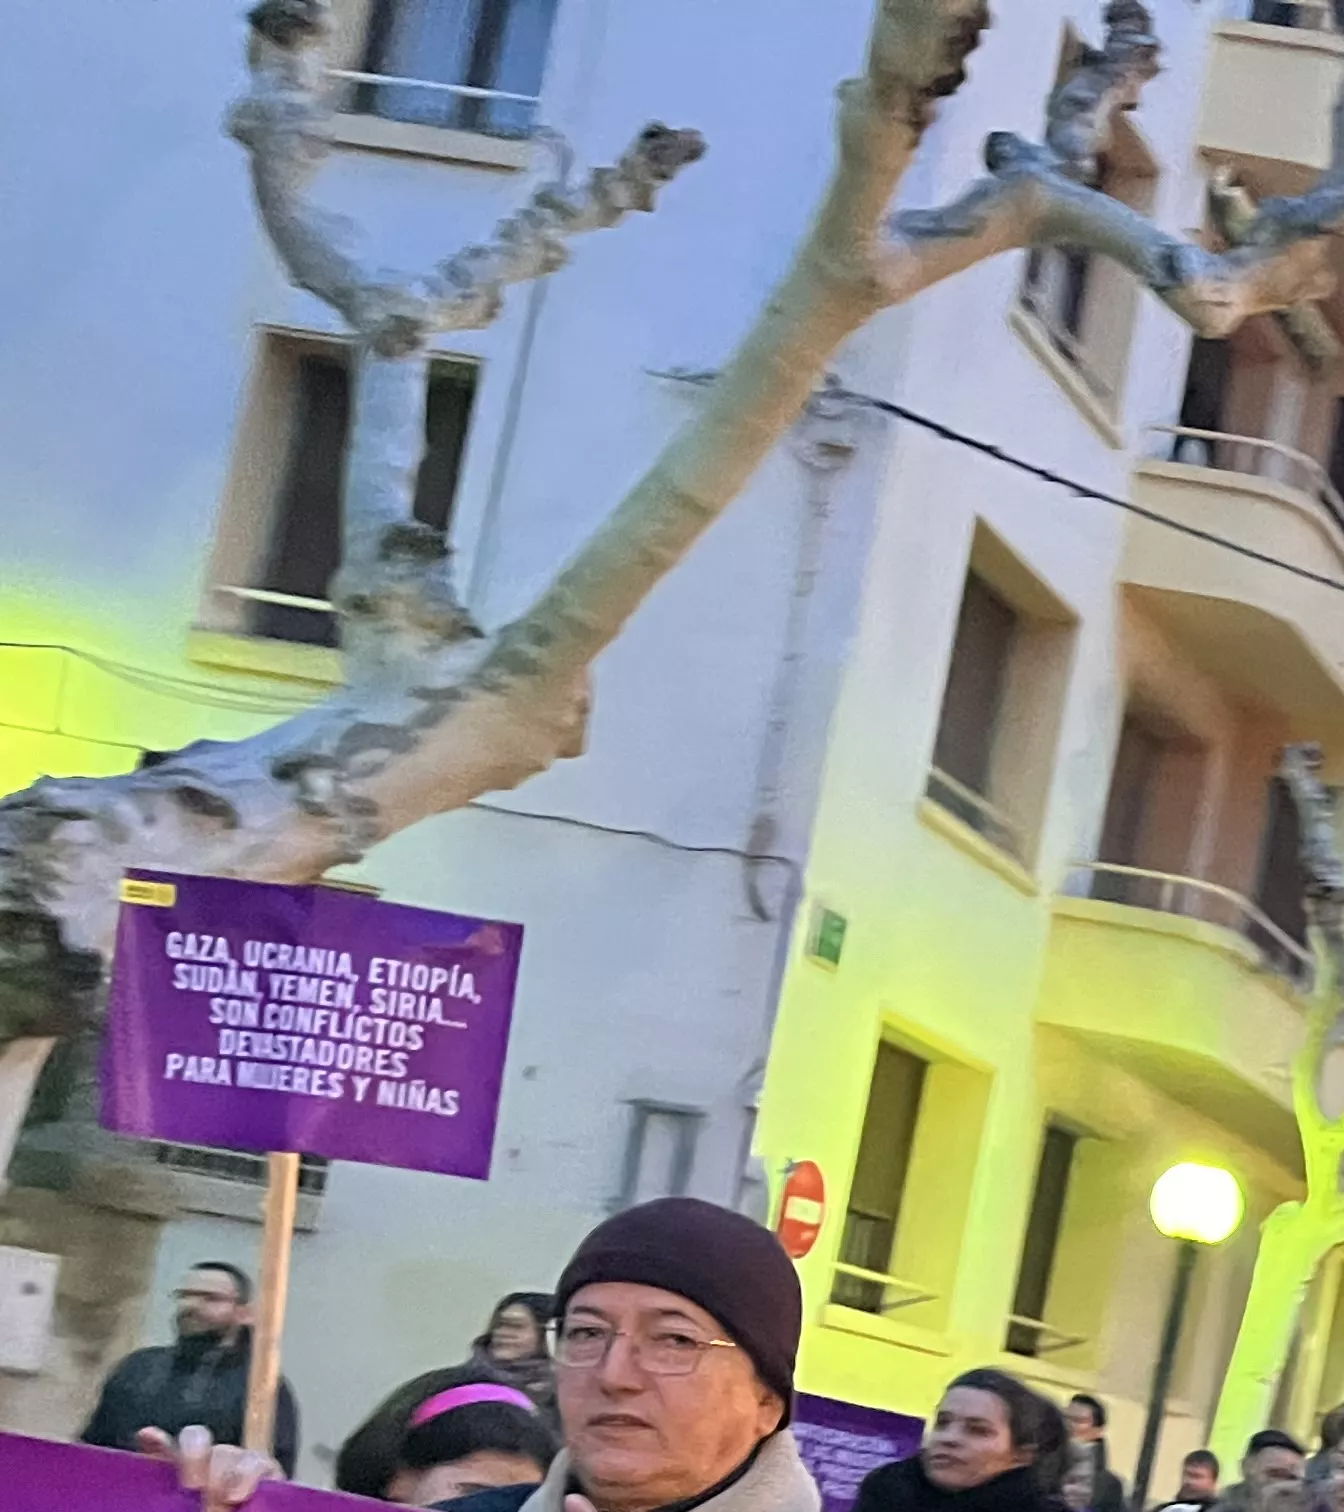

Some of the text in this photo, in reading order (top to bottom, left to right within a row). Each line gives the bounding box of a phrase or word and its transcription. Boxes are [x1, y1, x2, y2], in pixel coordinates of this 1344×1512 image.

[165, 931, 481, 1004] GAZA, UCRANIA, ETIOPÍA,
[269, 973, 361, 1012] YEMEN,
[209, 998, 424, 1050] SON CONFLICTOS
[219, 1029, 409, 1077] DEVASTADORES
[164, 1053, 232, 1086] PARA
[351, 1076, 372, 1102] Y
[376, 1079, 459, 1116] NIÑAS
